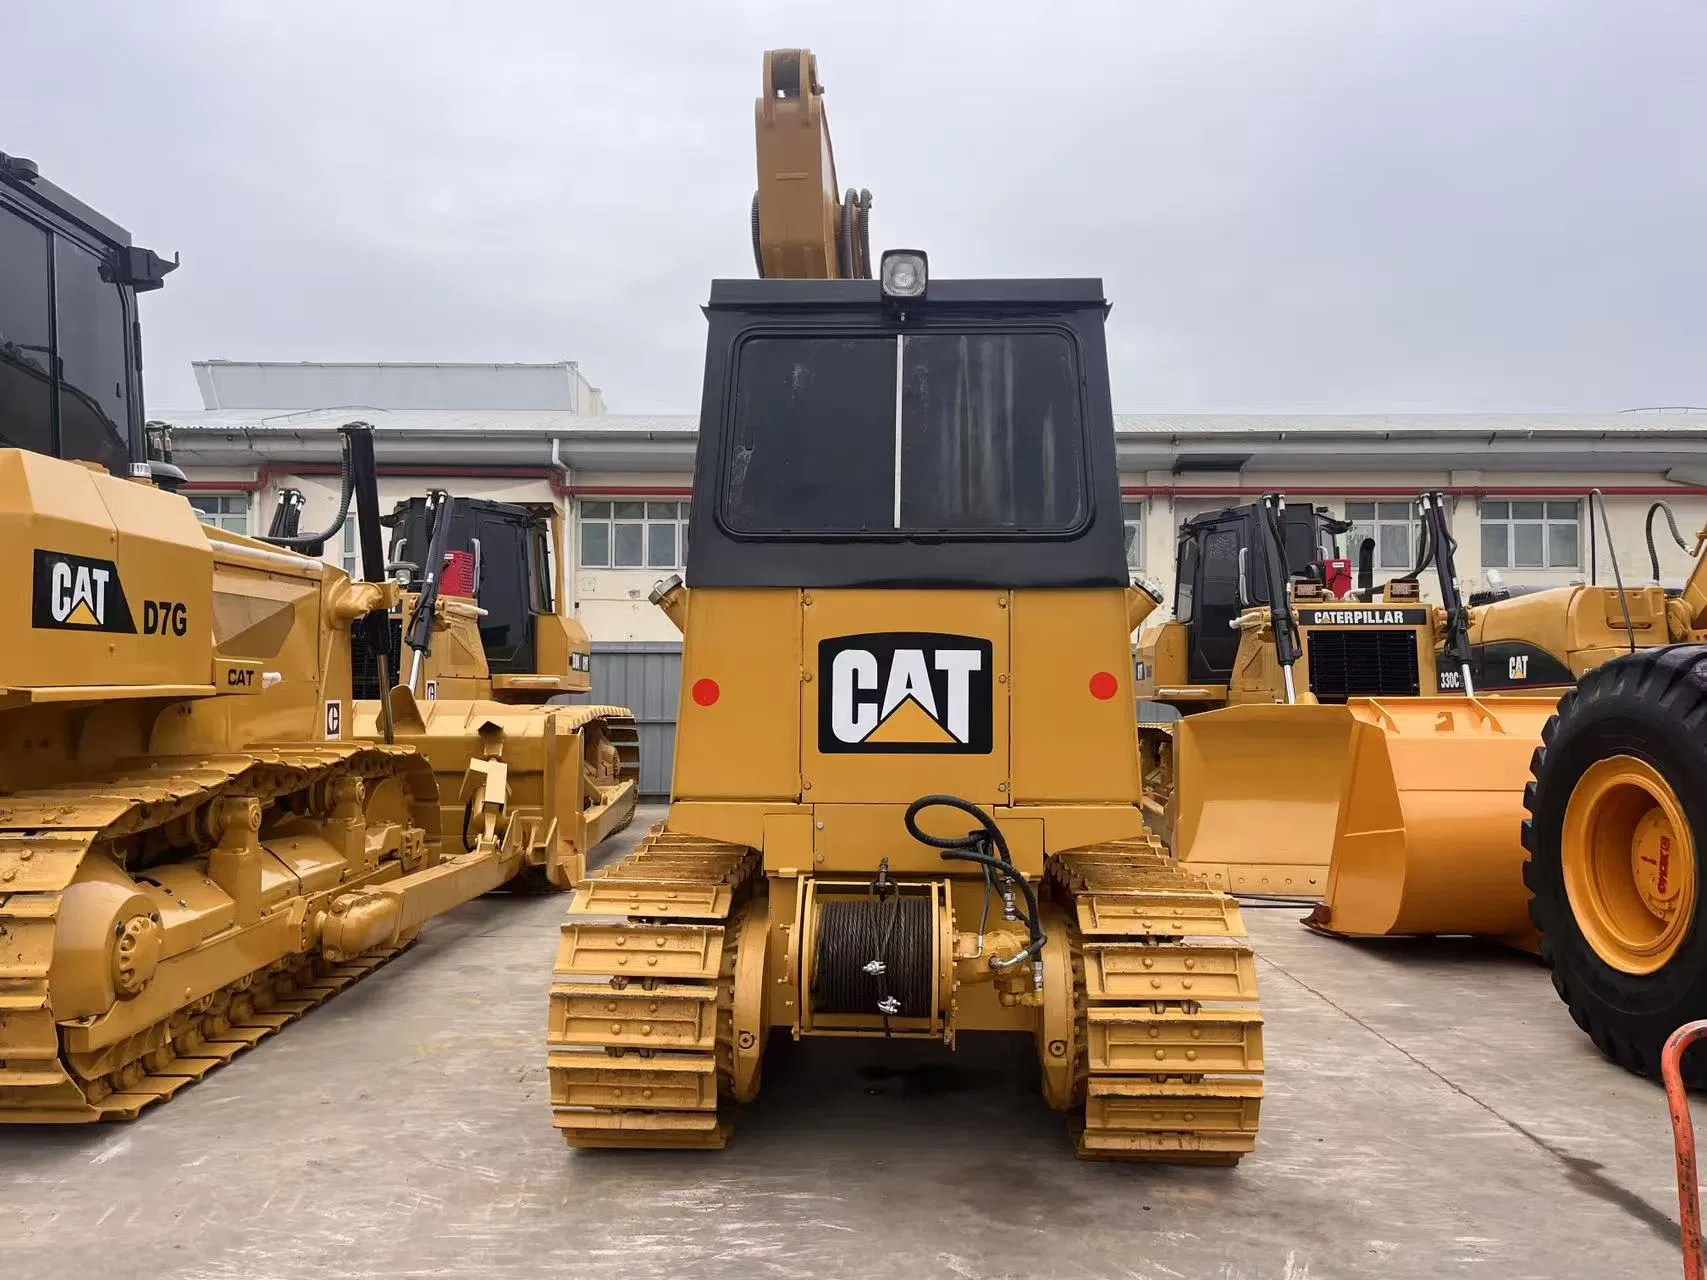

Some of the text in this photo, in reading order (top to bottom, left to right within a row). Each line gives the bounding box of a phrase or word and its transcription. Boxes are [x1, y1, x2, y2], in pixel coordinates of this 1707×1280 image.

[51, 561, 110, 625] CAT
[143, 600, 187, 637] D7G
[1314, 610, 1404, 624] CATERPILLAR
[227, 668, 255, 686] CAT
[1508, 655, 1529, 680] CAT
[831, 648, 982, 744] CAT
